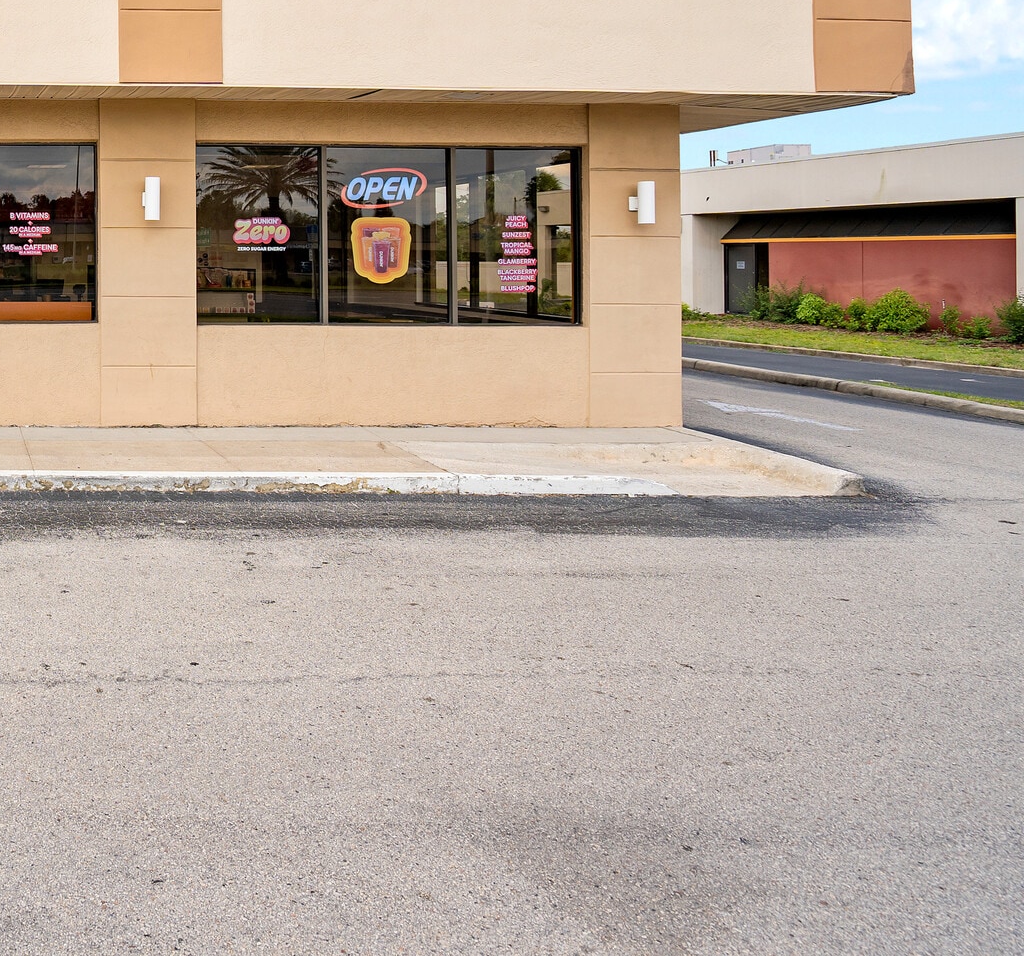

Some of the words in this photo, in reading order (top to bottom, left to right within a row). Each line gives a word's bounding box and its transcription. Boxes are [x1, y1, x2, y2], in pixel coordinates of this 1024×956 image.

[346, 176, 418, 201] OPEN
[16, 212, 50, 220] VITAMINS
[9, 226, 19, 234] 20
[19, 226, 51, 234] CALORIES
[234, 219, 289, 243] Zero
[23, 244, 58, 252] CAFFEINE
[497, 258, 537, 266] GLAMBERRY
